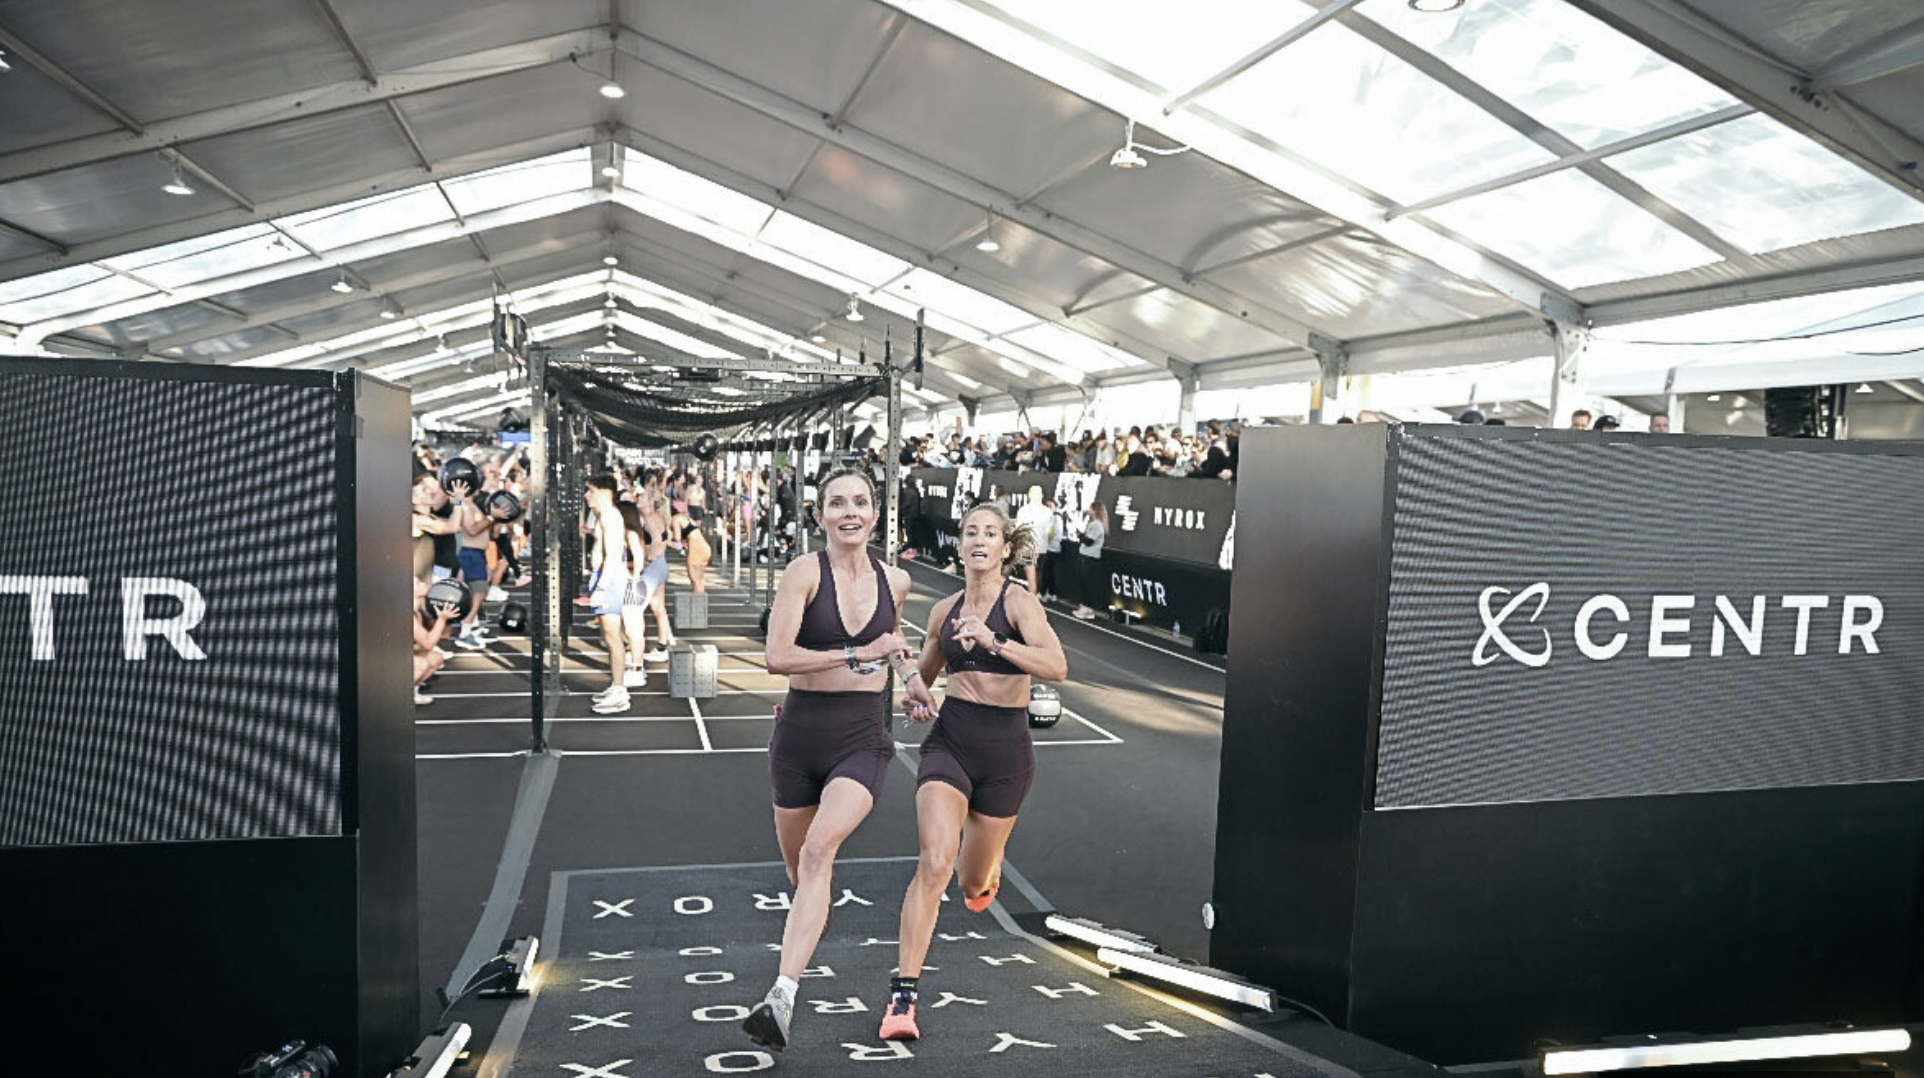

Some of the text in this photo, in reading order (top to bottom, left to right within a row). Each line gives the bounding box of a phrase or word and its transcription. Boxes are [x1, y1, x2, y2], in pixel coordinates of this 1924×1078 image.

[1153, 506, 1206, 531] HYROX
[1111, 572, 1167, 607] CENTR
[1574, 593, 1885, 661] CENTR
[592, 888, 950, 919] YROX
